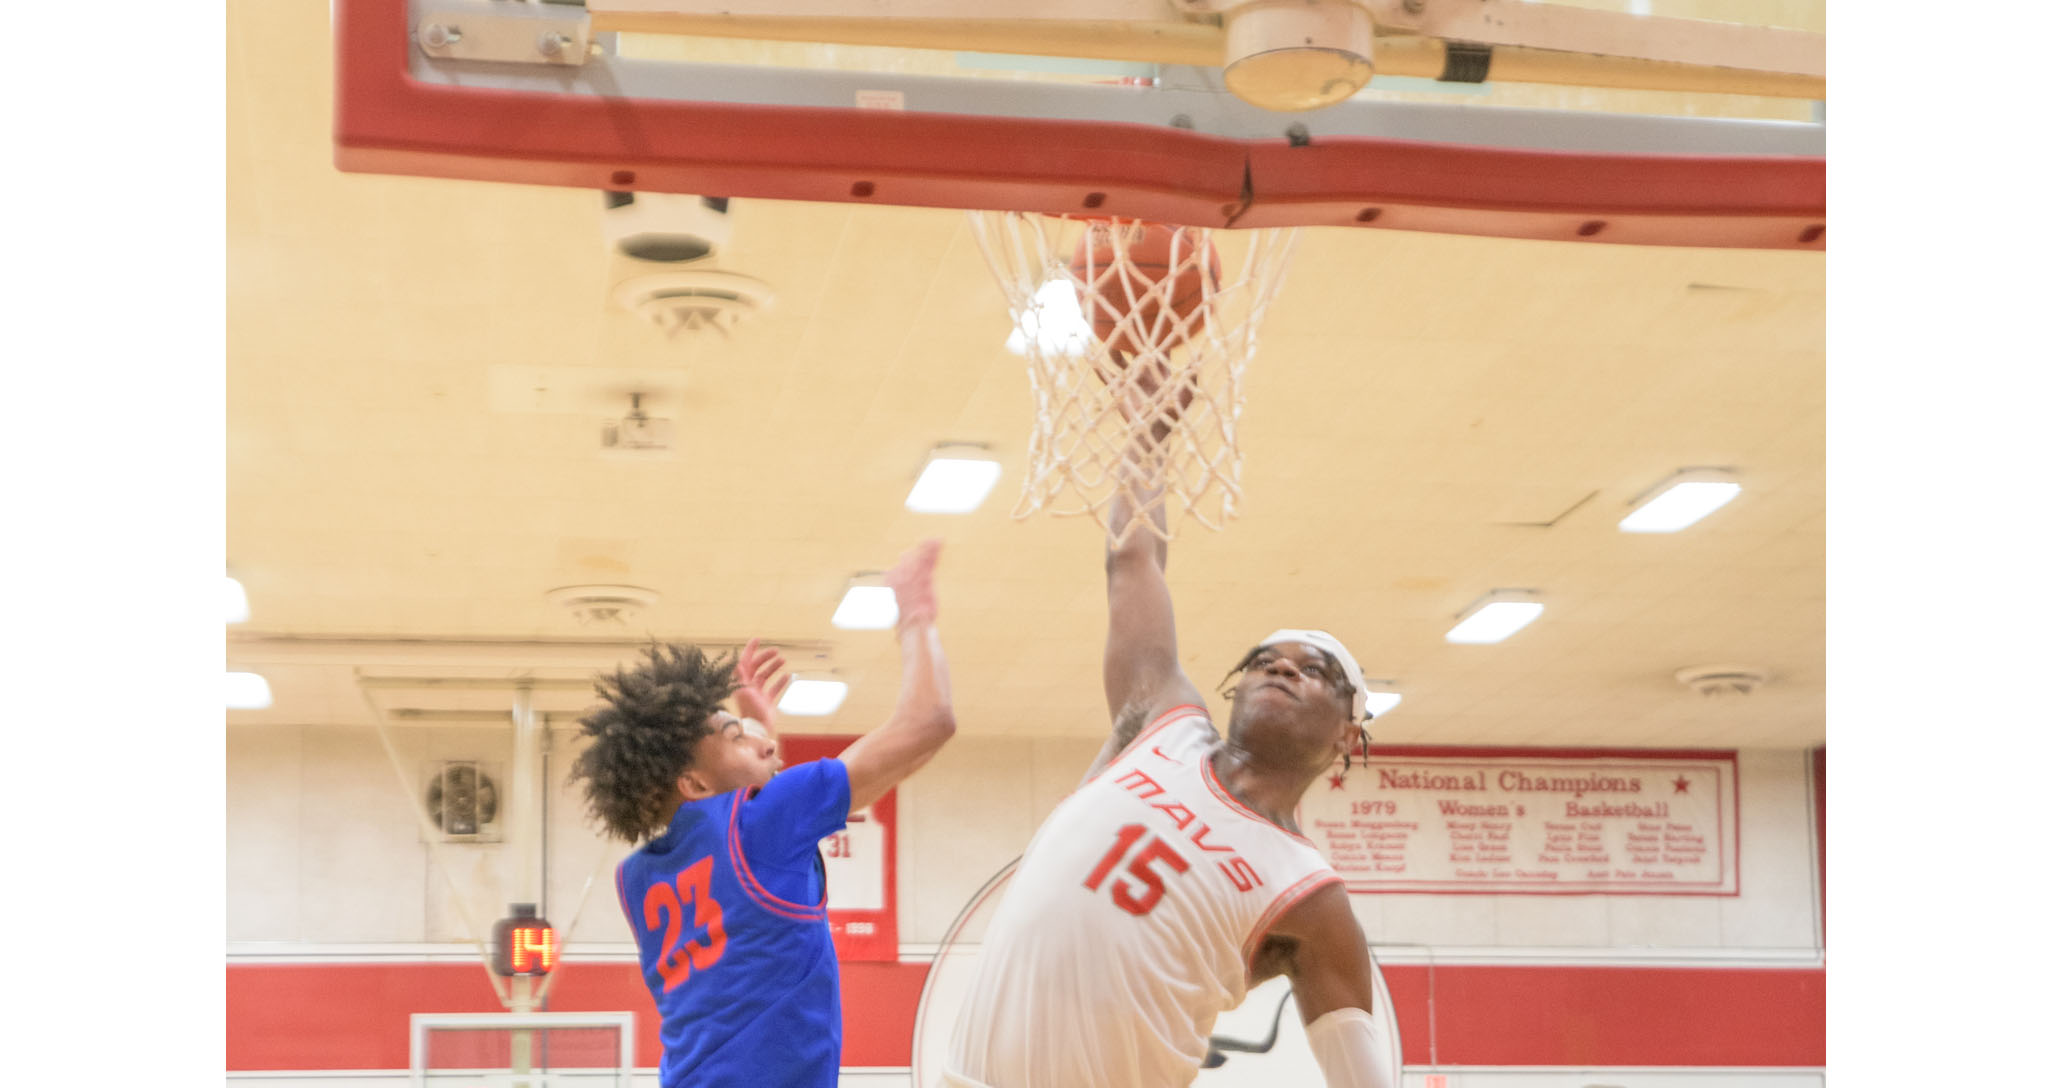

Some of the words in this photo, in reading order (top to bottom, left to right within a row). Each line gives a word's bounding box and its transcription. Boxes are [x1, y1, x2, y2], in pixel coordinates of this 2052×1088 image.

[1378, 769, 1487, 791] National
[1499, 770, 1641, 798] Champions
[1351, 801, 1396, 815] 1979
[1438, 800, 1526, 817] Women's
[1565, 802, 1669, 818] Basketball
[826, 834, 851, 858] 31
[1114, 768, 1264, 893] MAVS
[1082, 823, 1190, 917] 15
[643, 854, 728, 994] 23
[513, 928, 553, 970] 14
